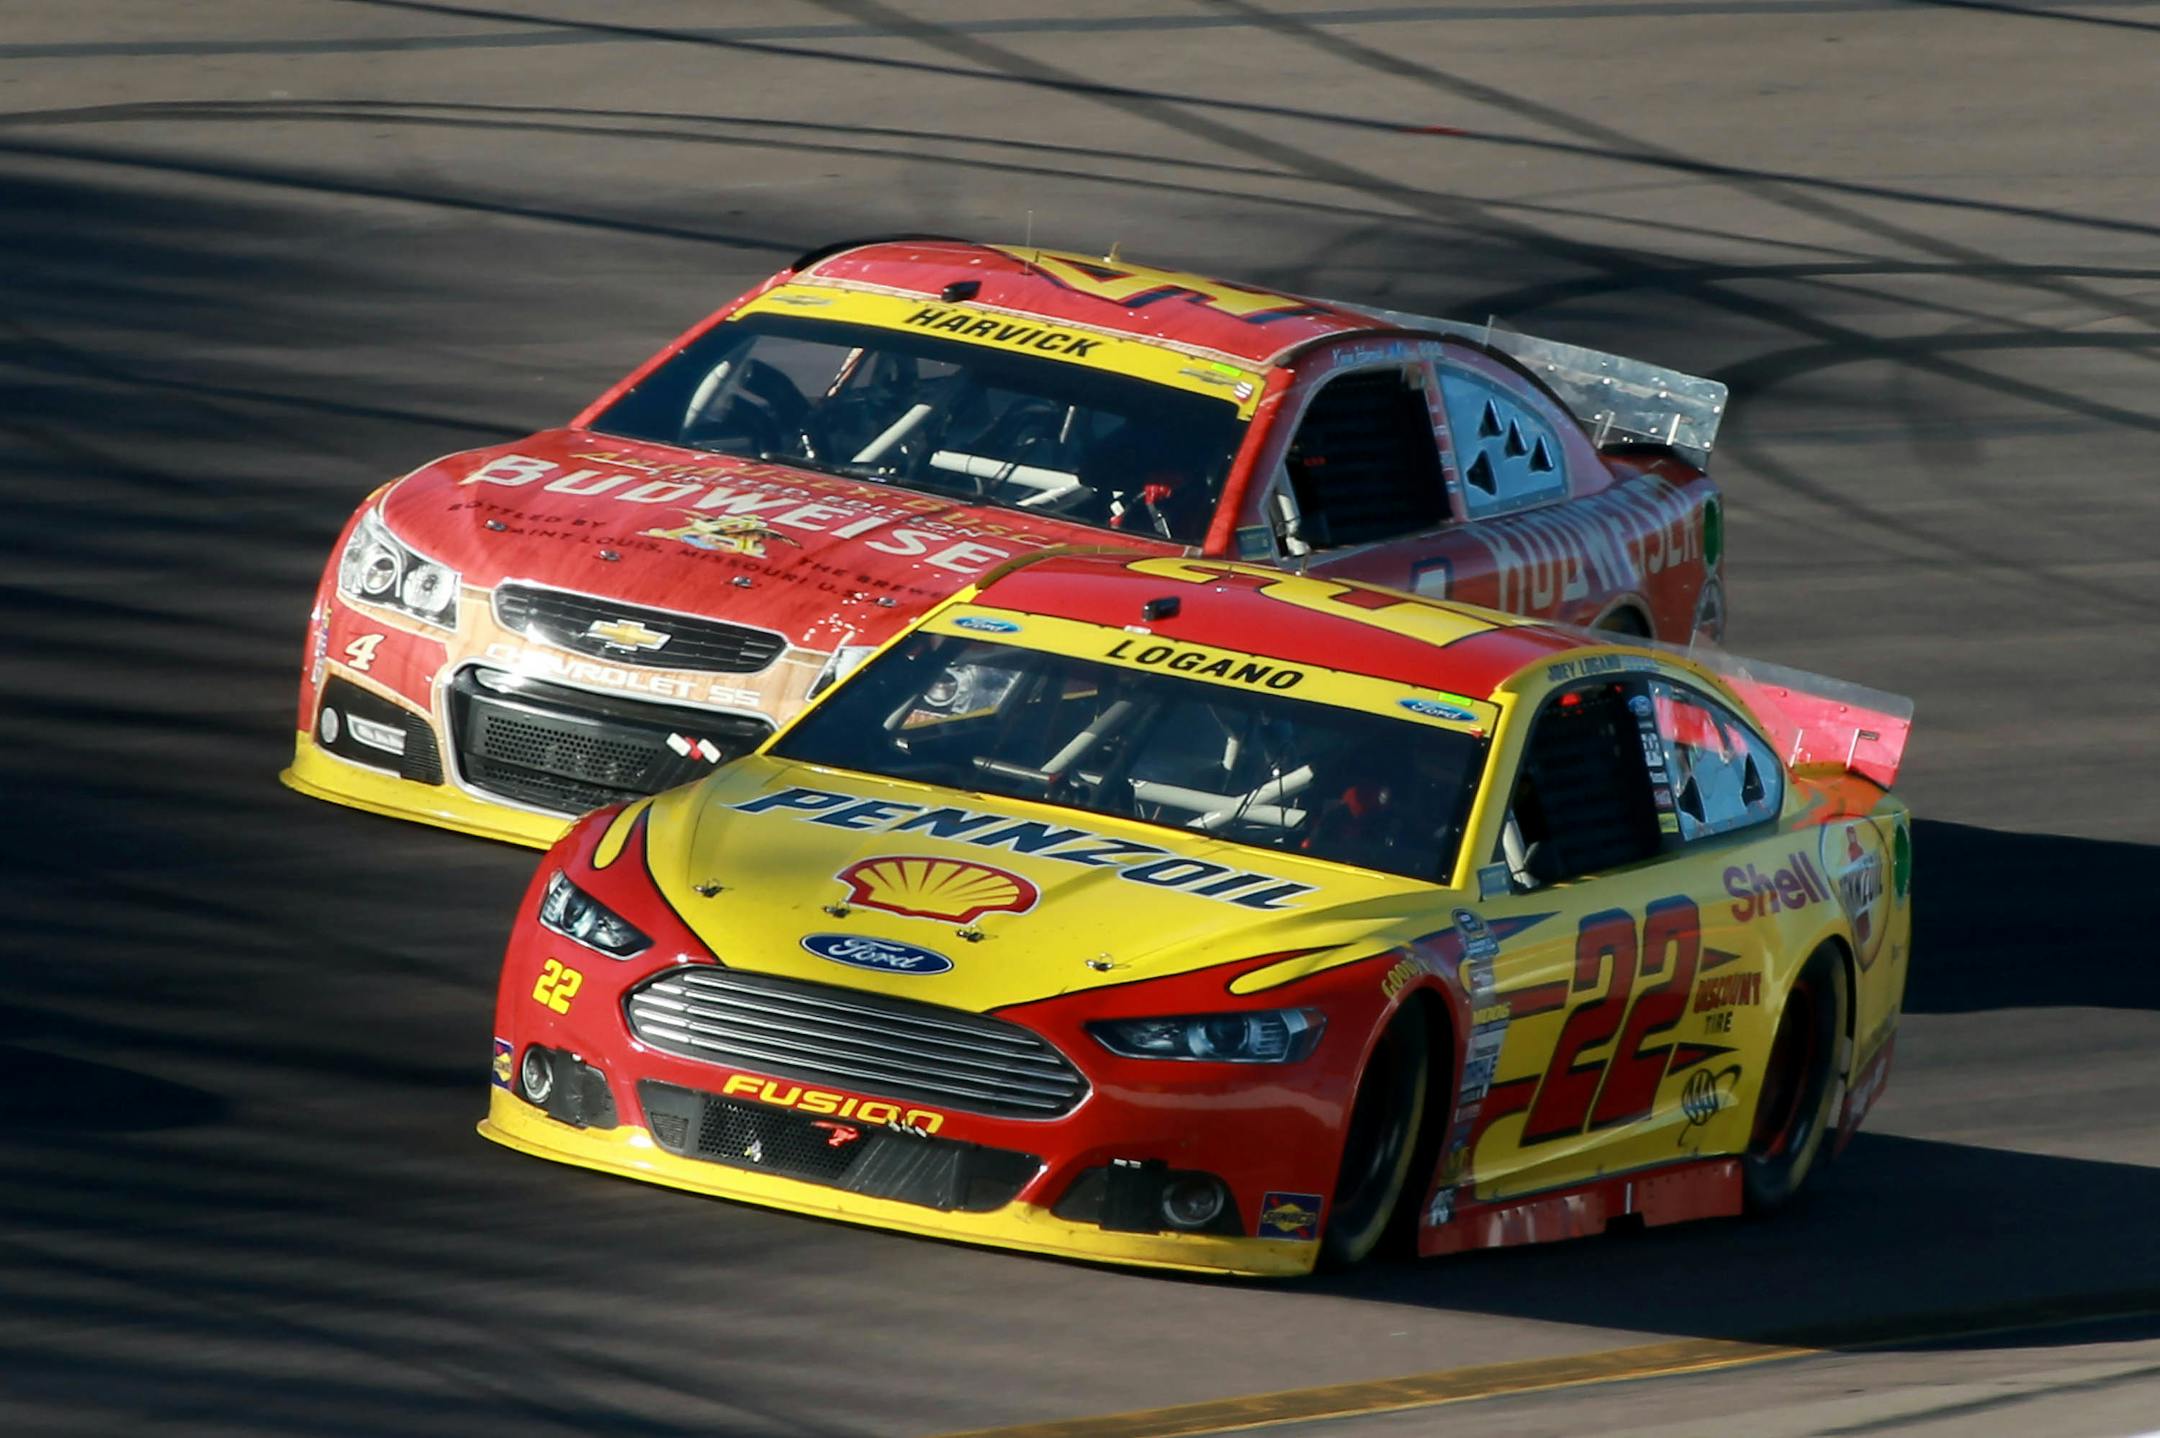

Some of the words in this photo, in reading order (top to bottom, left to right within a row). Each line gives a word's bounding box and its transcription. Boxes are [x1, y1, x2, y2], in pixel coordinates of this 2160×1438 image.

[907, 308, 1105, 358] HARVICK
[458, 454, 1010, 574] BUDWEISE
[568, 452, 1066, 549] ANHEUSER-BUSC
[798, 557, 849, 577] THE
[345, 633, 387, 672] 4
[486, 642, 699, 699] CVROLET
[708, 685, 761, 707] SS
[1106, 639, 1304, 691] LOGANO
[731, 786, 1320, 911] PENNZOIL
[1722, 851, 1831, 922] Shell
[830, 937, 925, 970] Ford
[532, 957, 584, 1016] 22
[1693, 971, 1762, 1014] DISCOUNT
[1519, 894, 1701, 1148] 22
[1704, 1010, 1734, 1035] TIRE
[723, 1074, 945, 1136] FUSION
